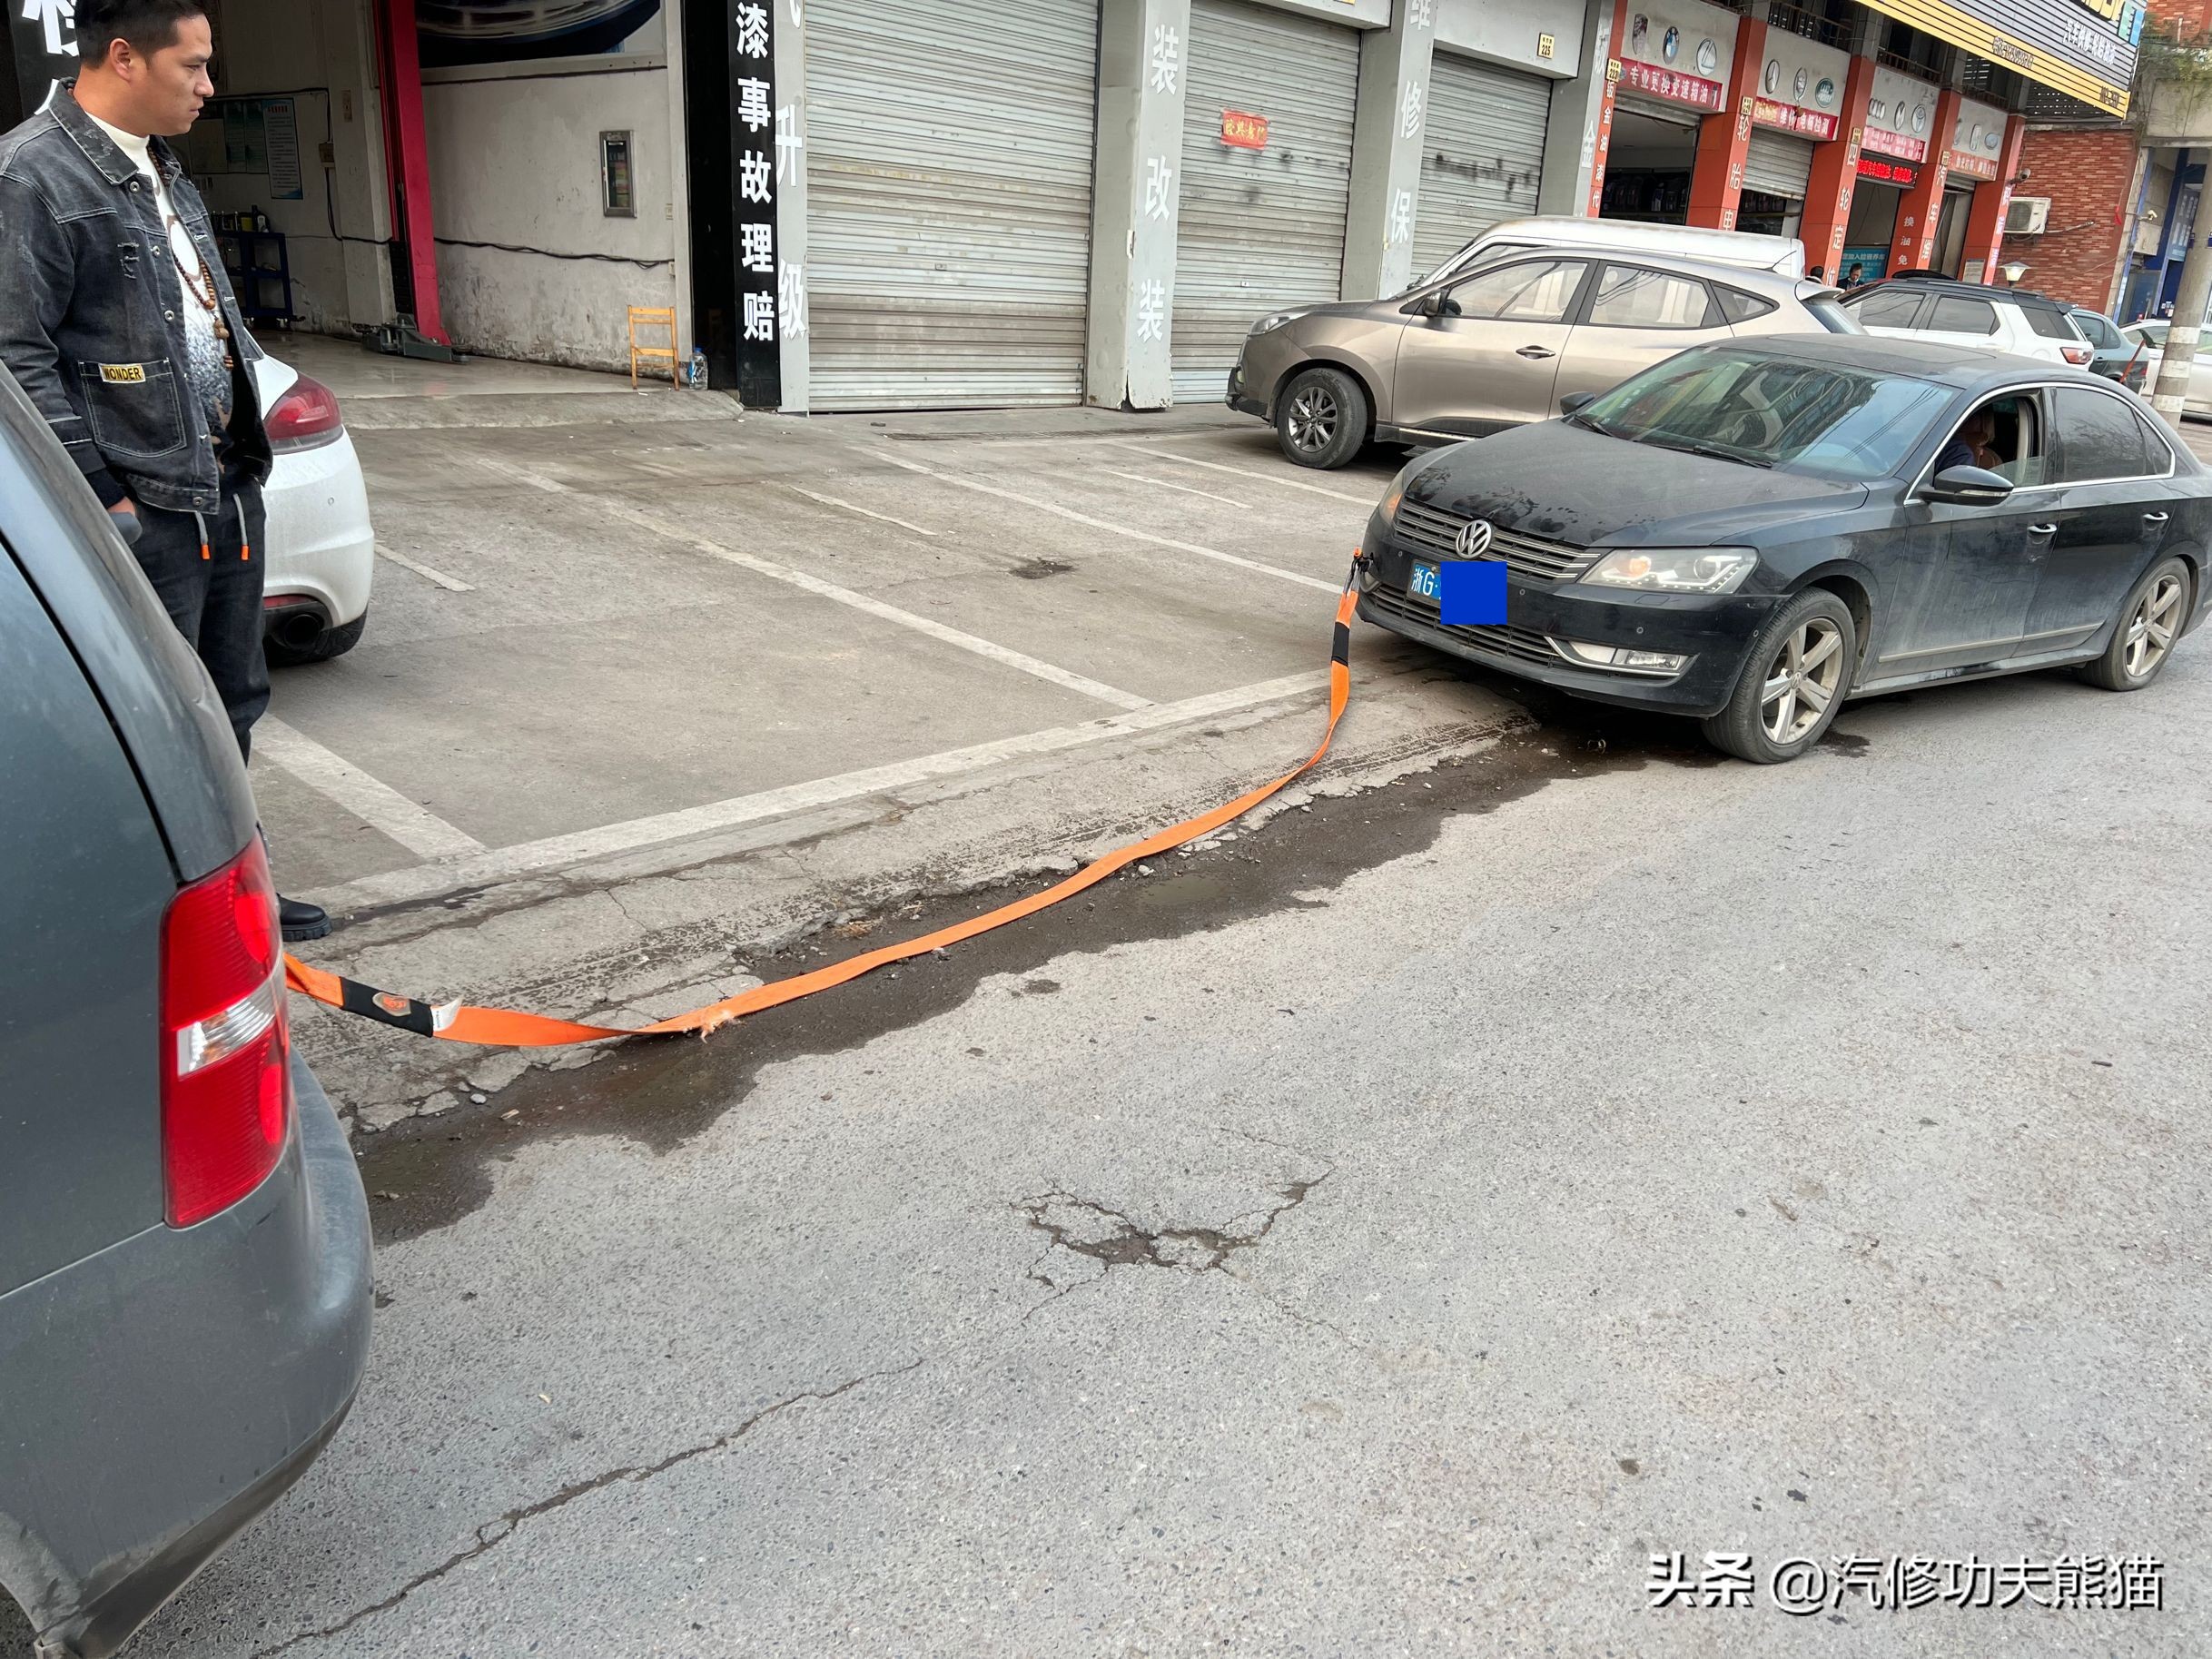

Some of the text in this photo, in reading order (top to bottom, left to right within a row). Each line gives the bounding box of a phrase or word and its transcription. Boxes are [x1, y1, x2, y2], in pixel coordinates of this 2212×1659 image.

[1541, 44, 1551, 56] 225
[1630, 65, 1708, 104] 专业更换变速箱油
[775, 0, 807, 341] 升级
[104, 367, 142, 380] WONDER
